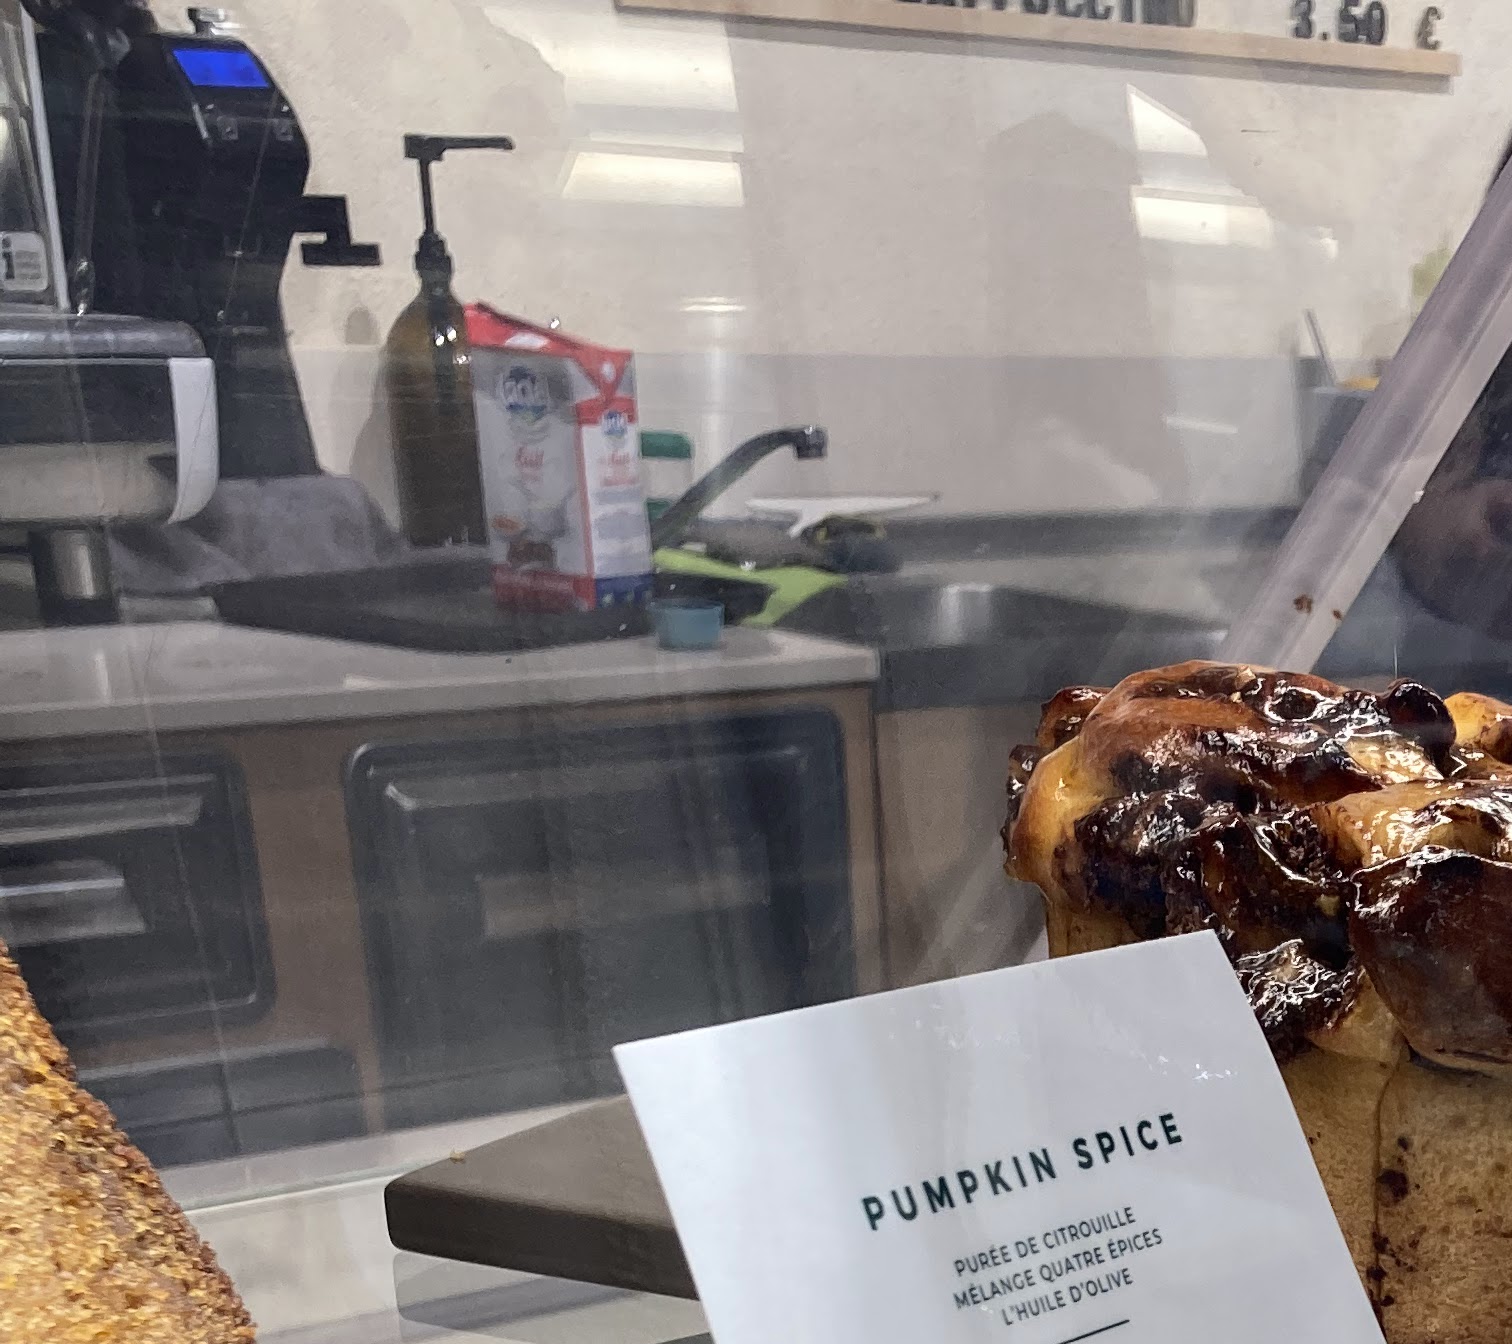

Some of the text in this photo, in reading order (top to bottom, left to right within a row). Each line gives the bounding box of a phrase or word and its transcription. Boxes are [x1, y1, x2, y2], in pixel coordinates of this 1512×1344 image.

[1292, 0, 1386, 46] 3.50
[862, 1113, 1182, 1231] PUMPKIN SPICE
[953, 1207, 1136, 1277] PURÉE DE CITROUILLE
[953, 1228, 1163, 1309] MÉLANGE QUATRE ÉPICES
[1001, 1268, 1133, 1325] L'HUILE D'OLIVE
